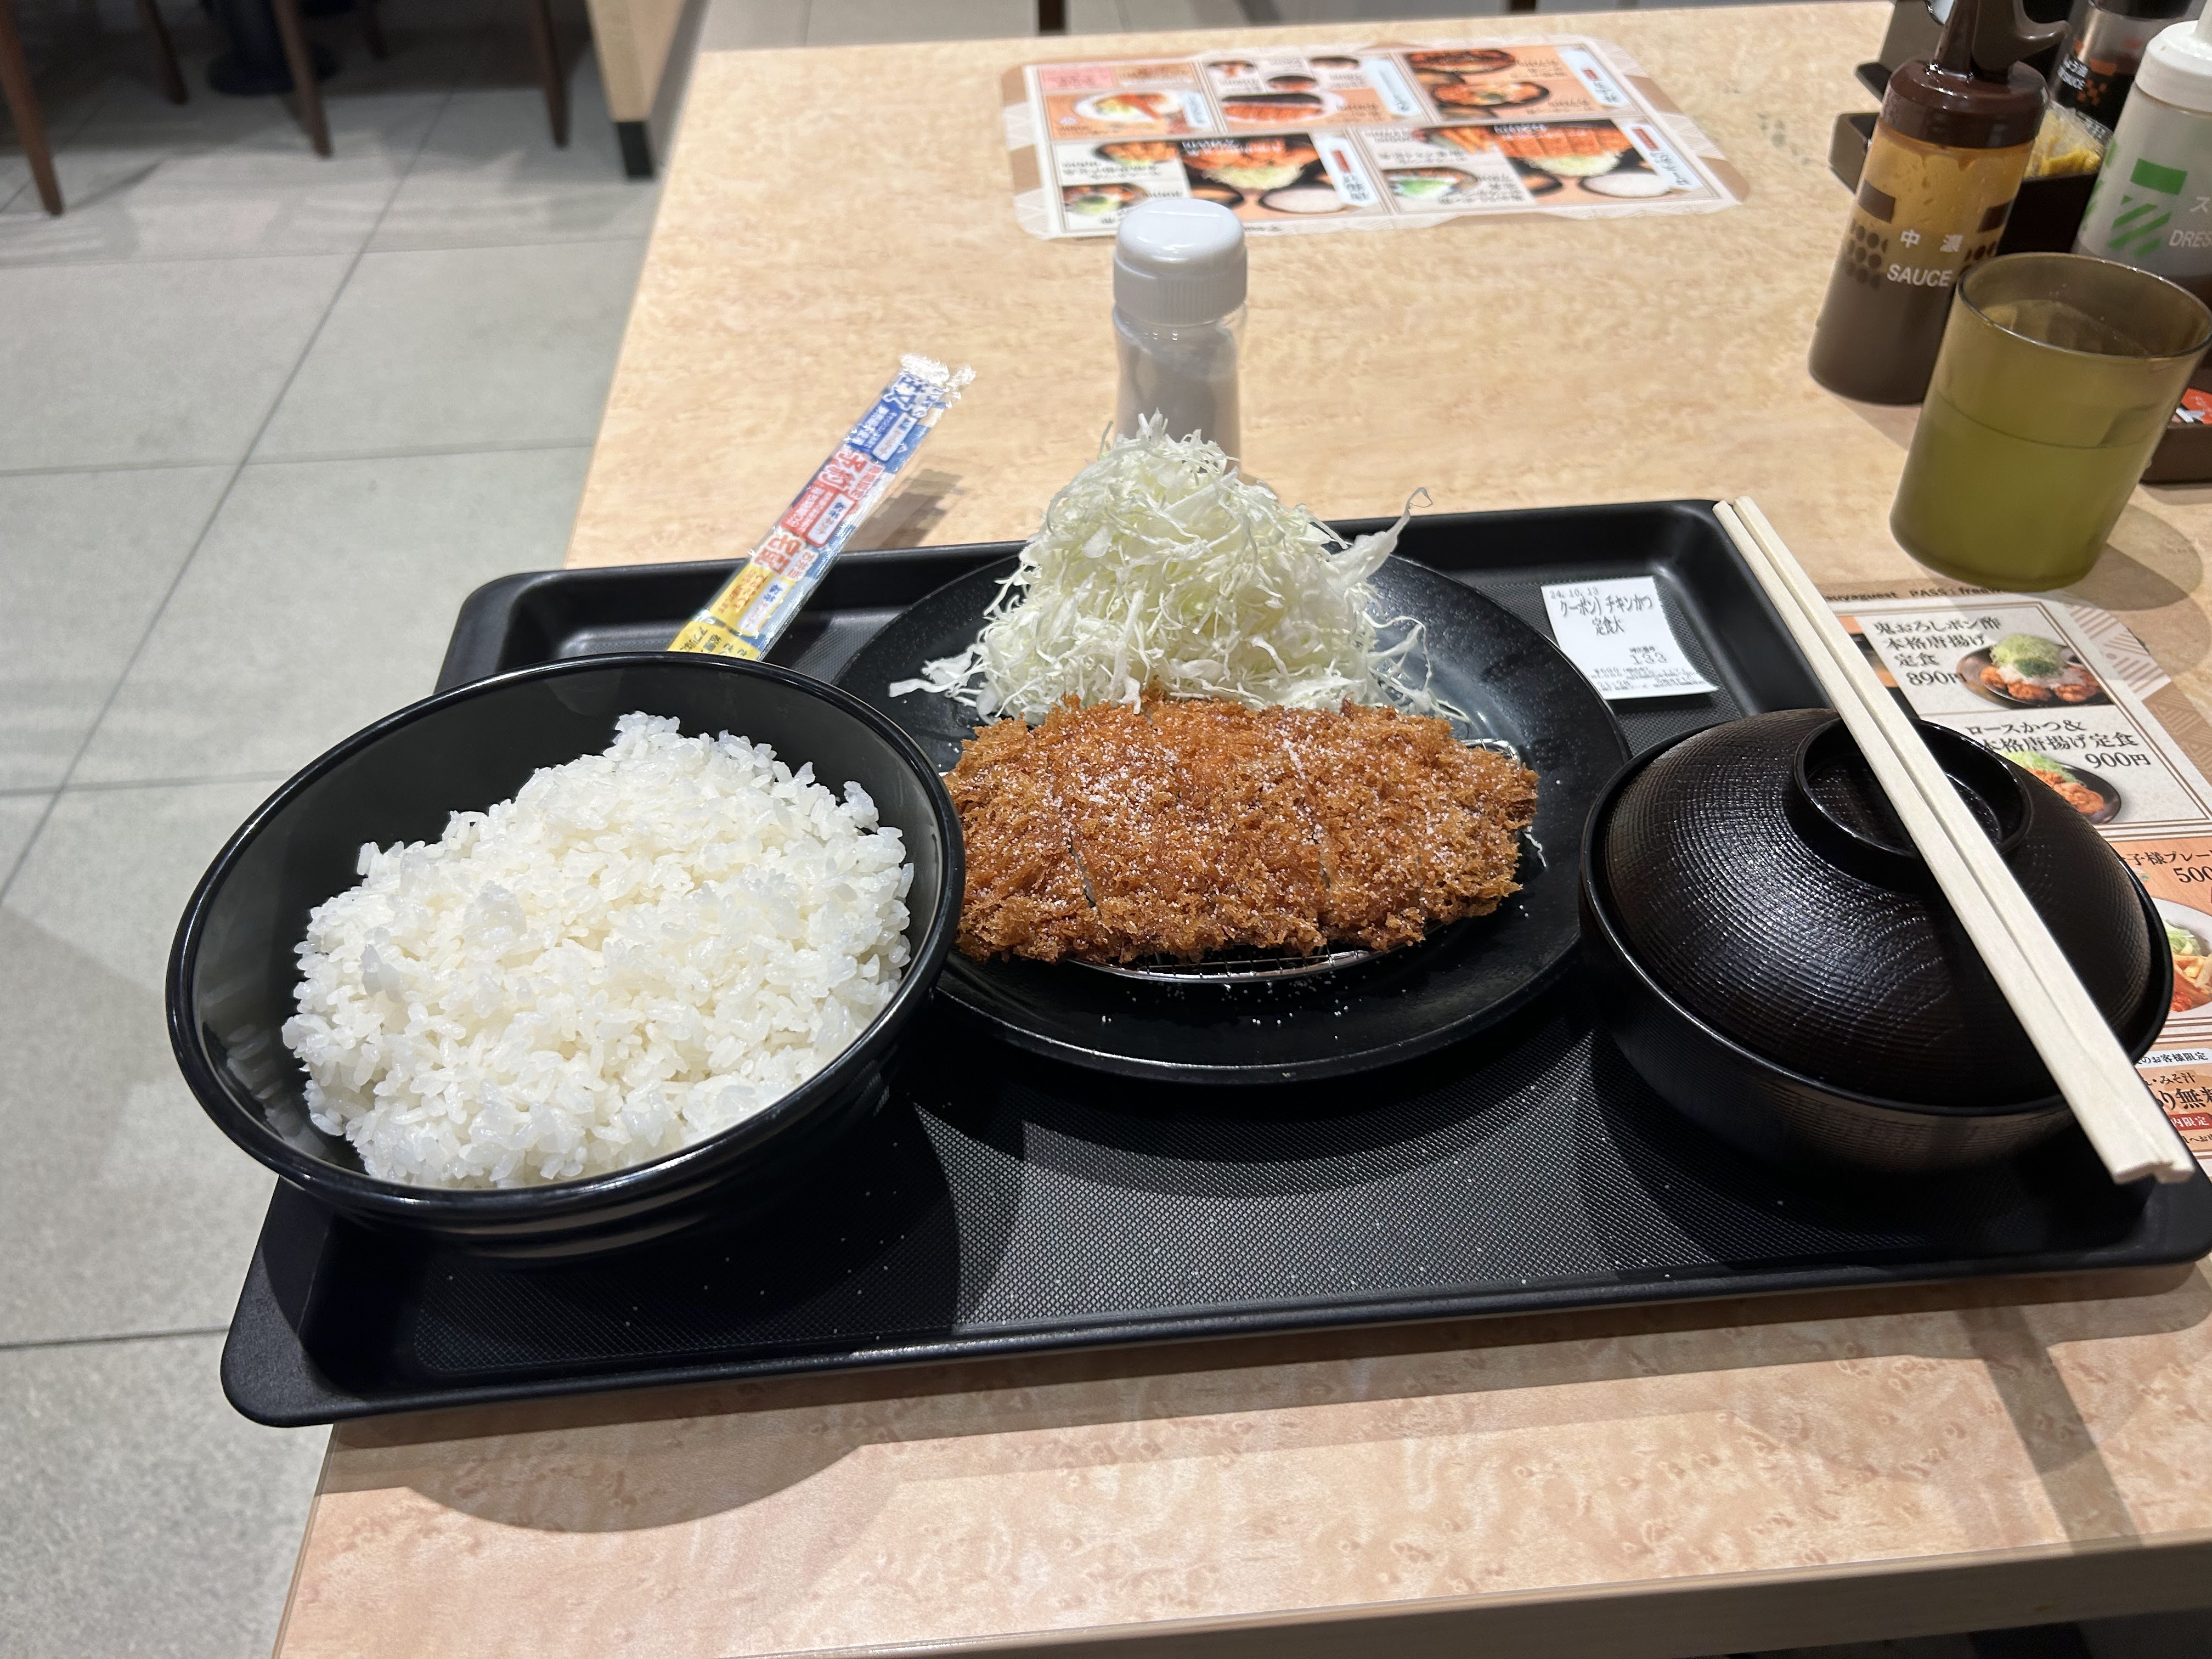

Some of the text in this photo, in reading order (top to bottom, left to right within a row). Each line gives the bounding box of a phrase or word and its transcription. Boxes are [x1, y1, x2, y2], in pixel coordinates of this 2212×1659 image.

[1886, 263, 1953, 287] SAUCE
[822, 452, 868, 489] 予約
[754, 534, 802, 575] 出前
[1874, 616, 2002, 635] 鬼おろしポン酢
[1883, 633, 1985, 651] 本格唐揚げ
[1893, 652, 1940, 667] 定食
[1906, 670, 1967, 686] 890円
[1965, 719, 2086, 735] ロースかつ&
[1981, 731, 2140, 753] 本格唐揚げ定食
[2084, 752, 2151, 769] 900円
[2122, 850, 2212, 866] 子様プレー
[2137, 1052, 2209, 1065] のお客様限定
